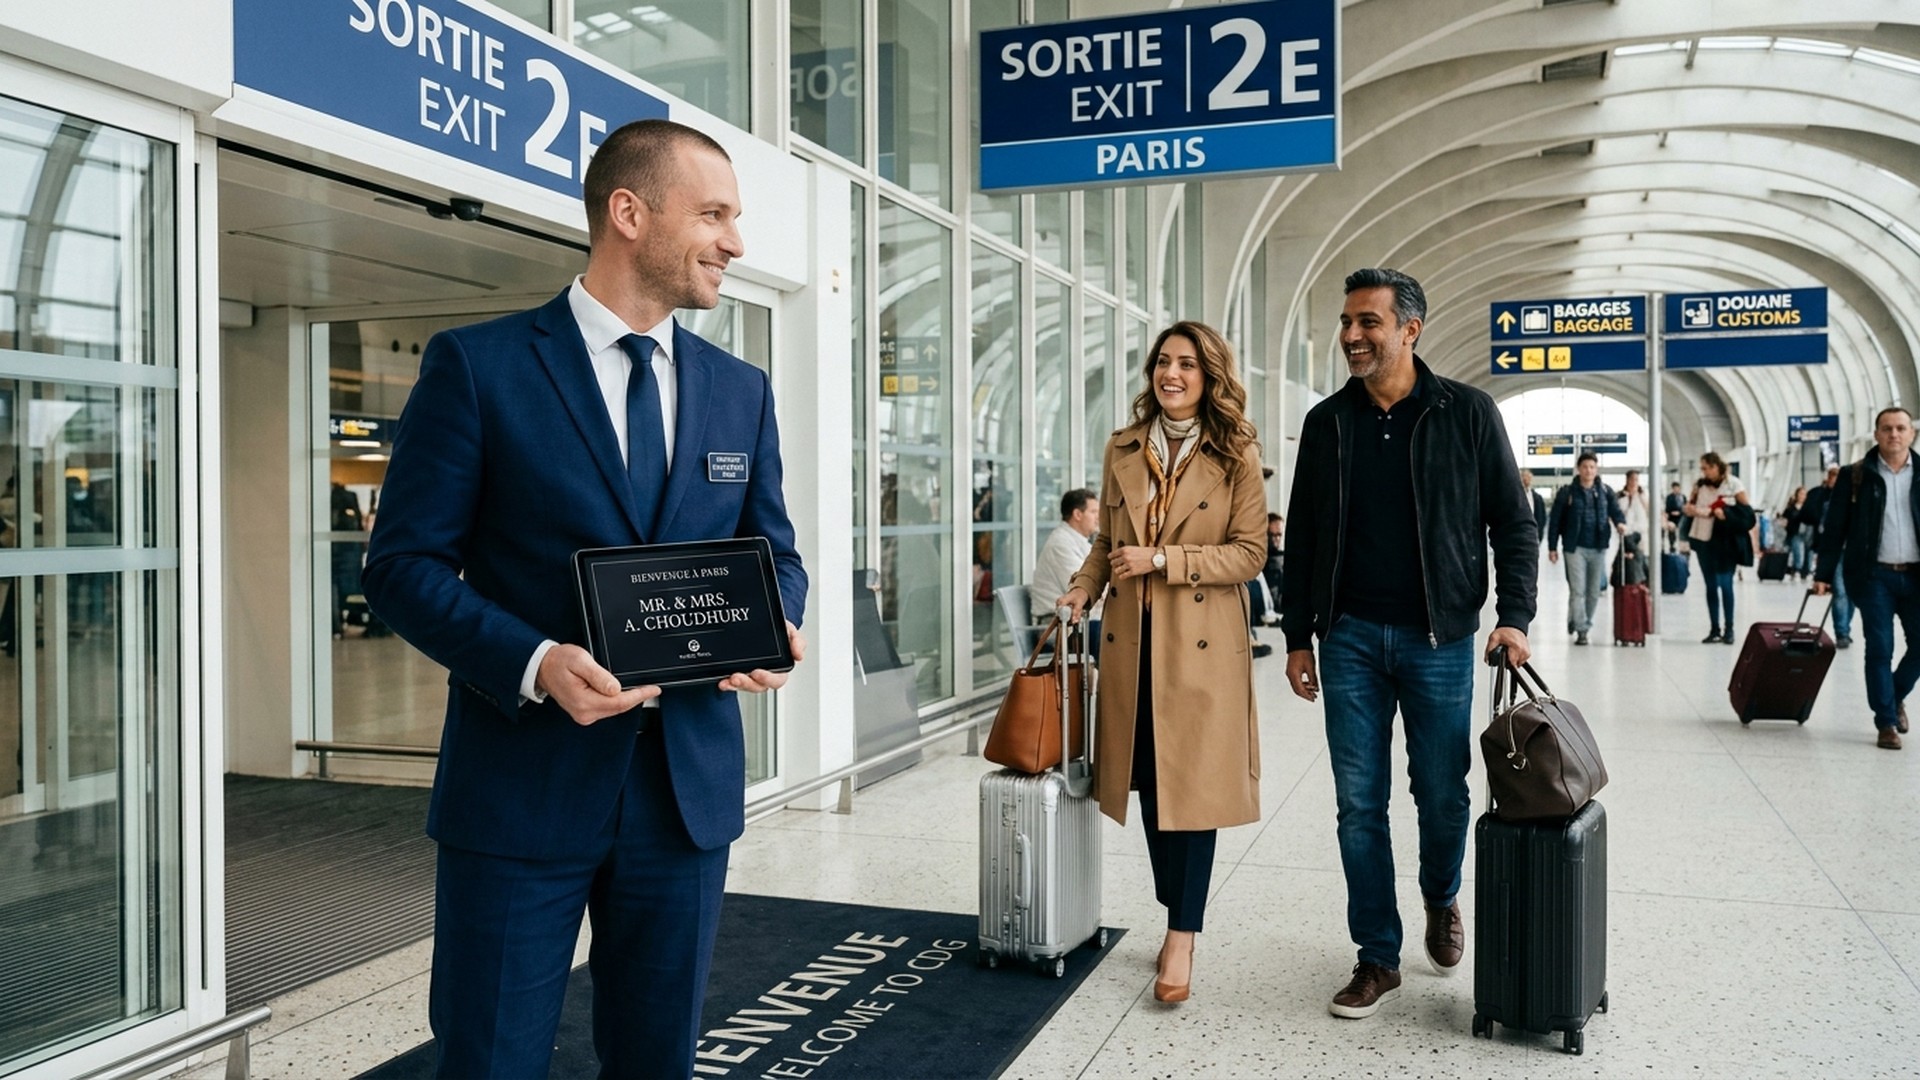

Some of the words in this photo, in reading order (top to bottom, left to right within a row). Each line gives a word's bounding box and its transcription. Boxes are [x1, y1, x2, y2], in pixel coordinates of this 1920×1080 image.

[350, 0, 505, 91] SORTIE
[1001, 28, 1162, 81] SORTIE
[1208, 17, 1320, 111] 2E
[420, 77, 506, 152] EXIT
[1071, 80, 1163, 122] EXIT
[1097, 136, 1206, 175] PARIS
[1553, 301, 1632, 318] BAGAGES
[1717, 293, 1792, 311] DOUANE
[1717, 309, 1801, 327] CUSTOMS
[1554, 317, 1633, 333] BAGGAGE
[700, 567, 729, 578] PARIS
[624, 618, 641, 632] A.
[643, 607, 750, 630] CHOUDHURY
[639, 597, 671, 613] MR.
[674, 596, 686, 610] &
[690, 592, 729, 608] MRS.
[692, 931, 910, 1080] IENVENUE
[760, 999, 895, 1080] ELCOME
[870, 973, 923, 994] TO
[906, 938, 968, 970] CDG
